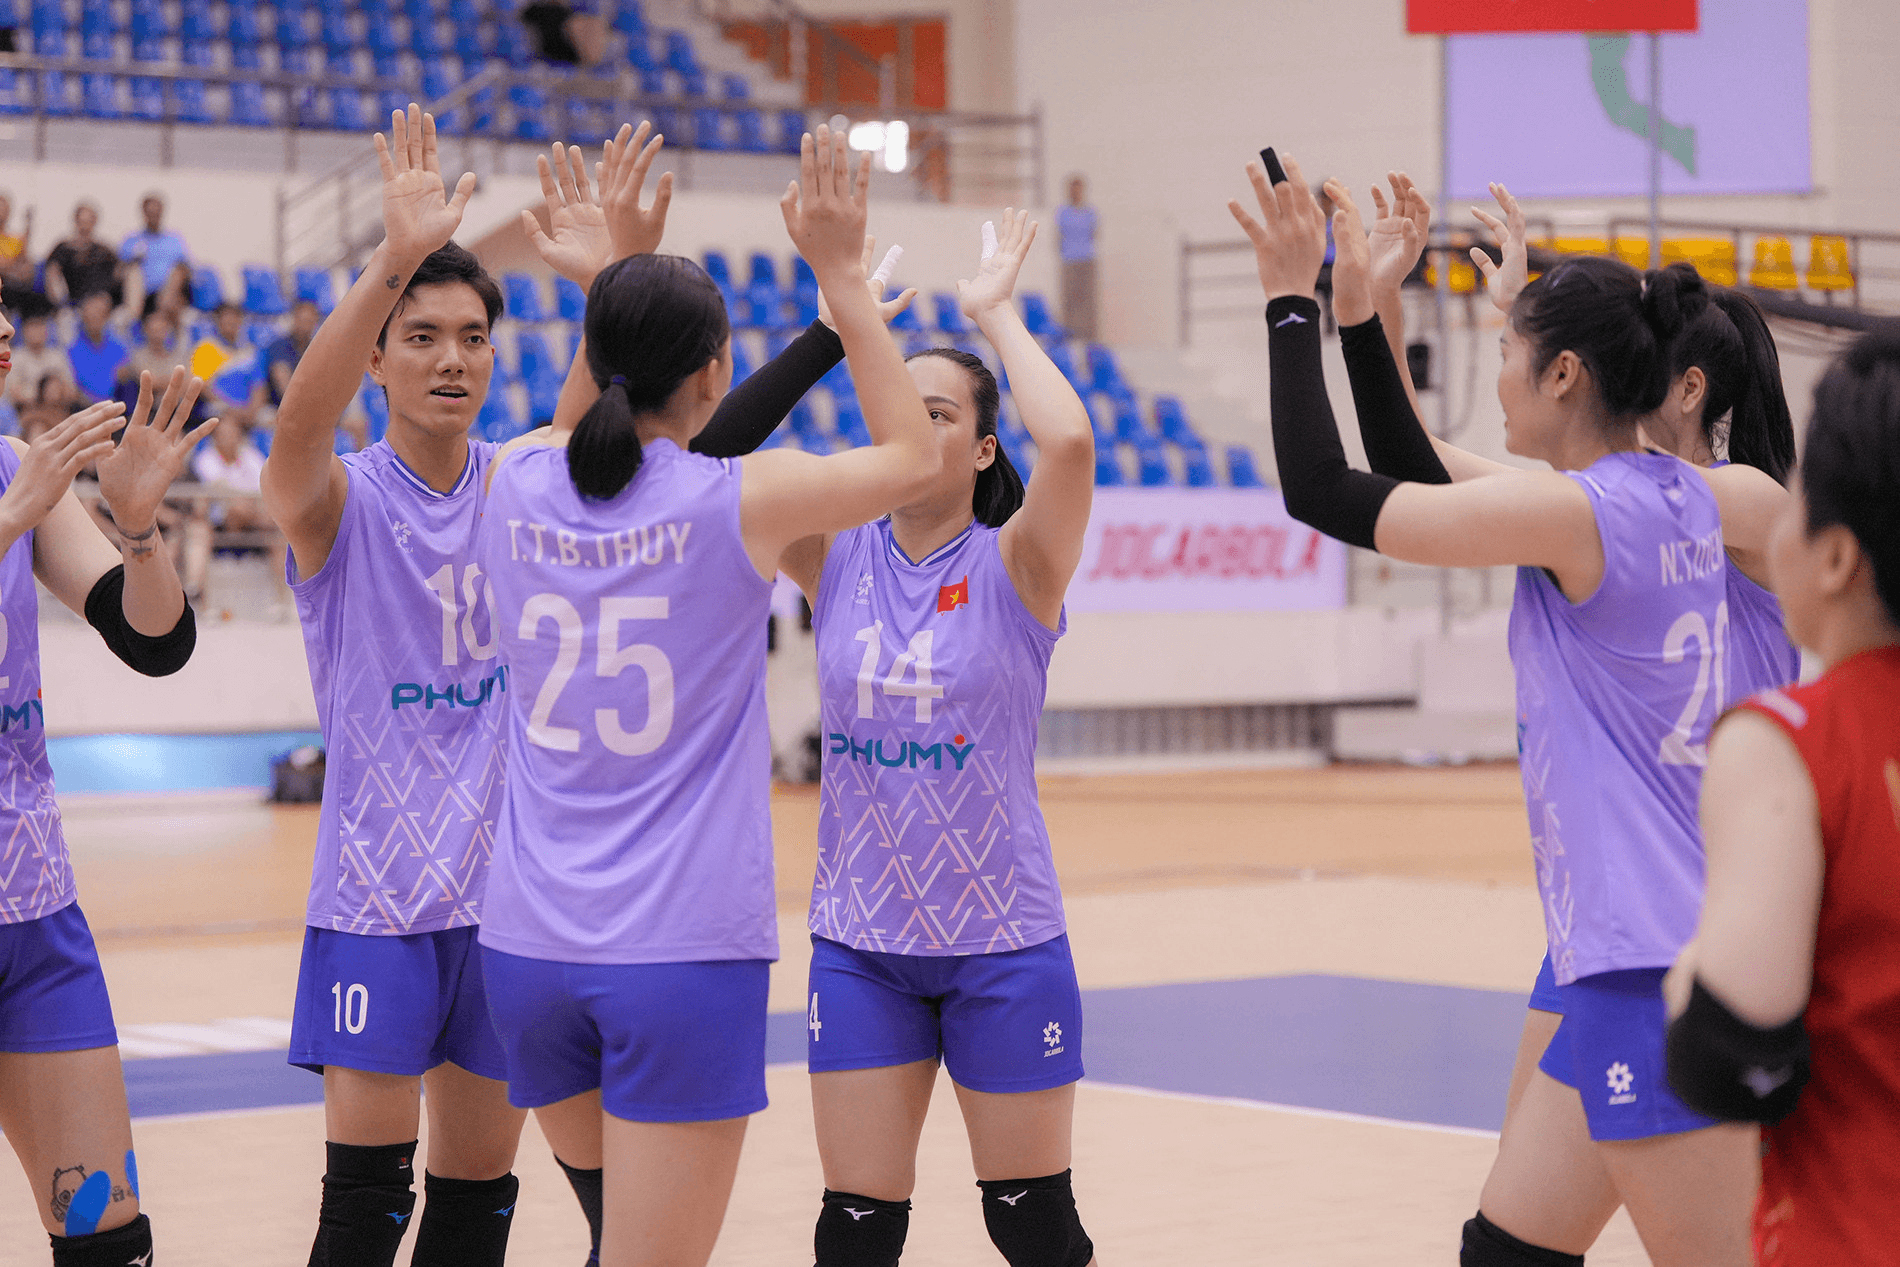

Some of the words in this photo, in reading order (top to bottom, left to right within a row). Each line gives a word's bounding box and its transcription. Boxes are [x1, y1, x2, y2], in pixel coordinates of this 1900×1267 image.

[423, 562, 501, 666] 10
[517, 593, 675, 756] 25
[854, 619, 944, 724] 14
[829, 733, 976, 770] PHUMY
[331, 981, 369, 1035] 10
